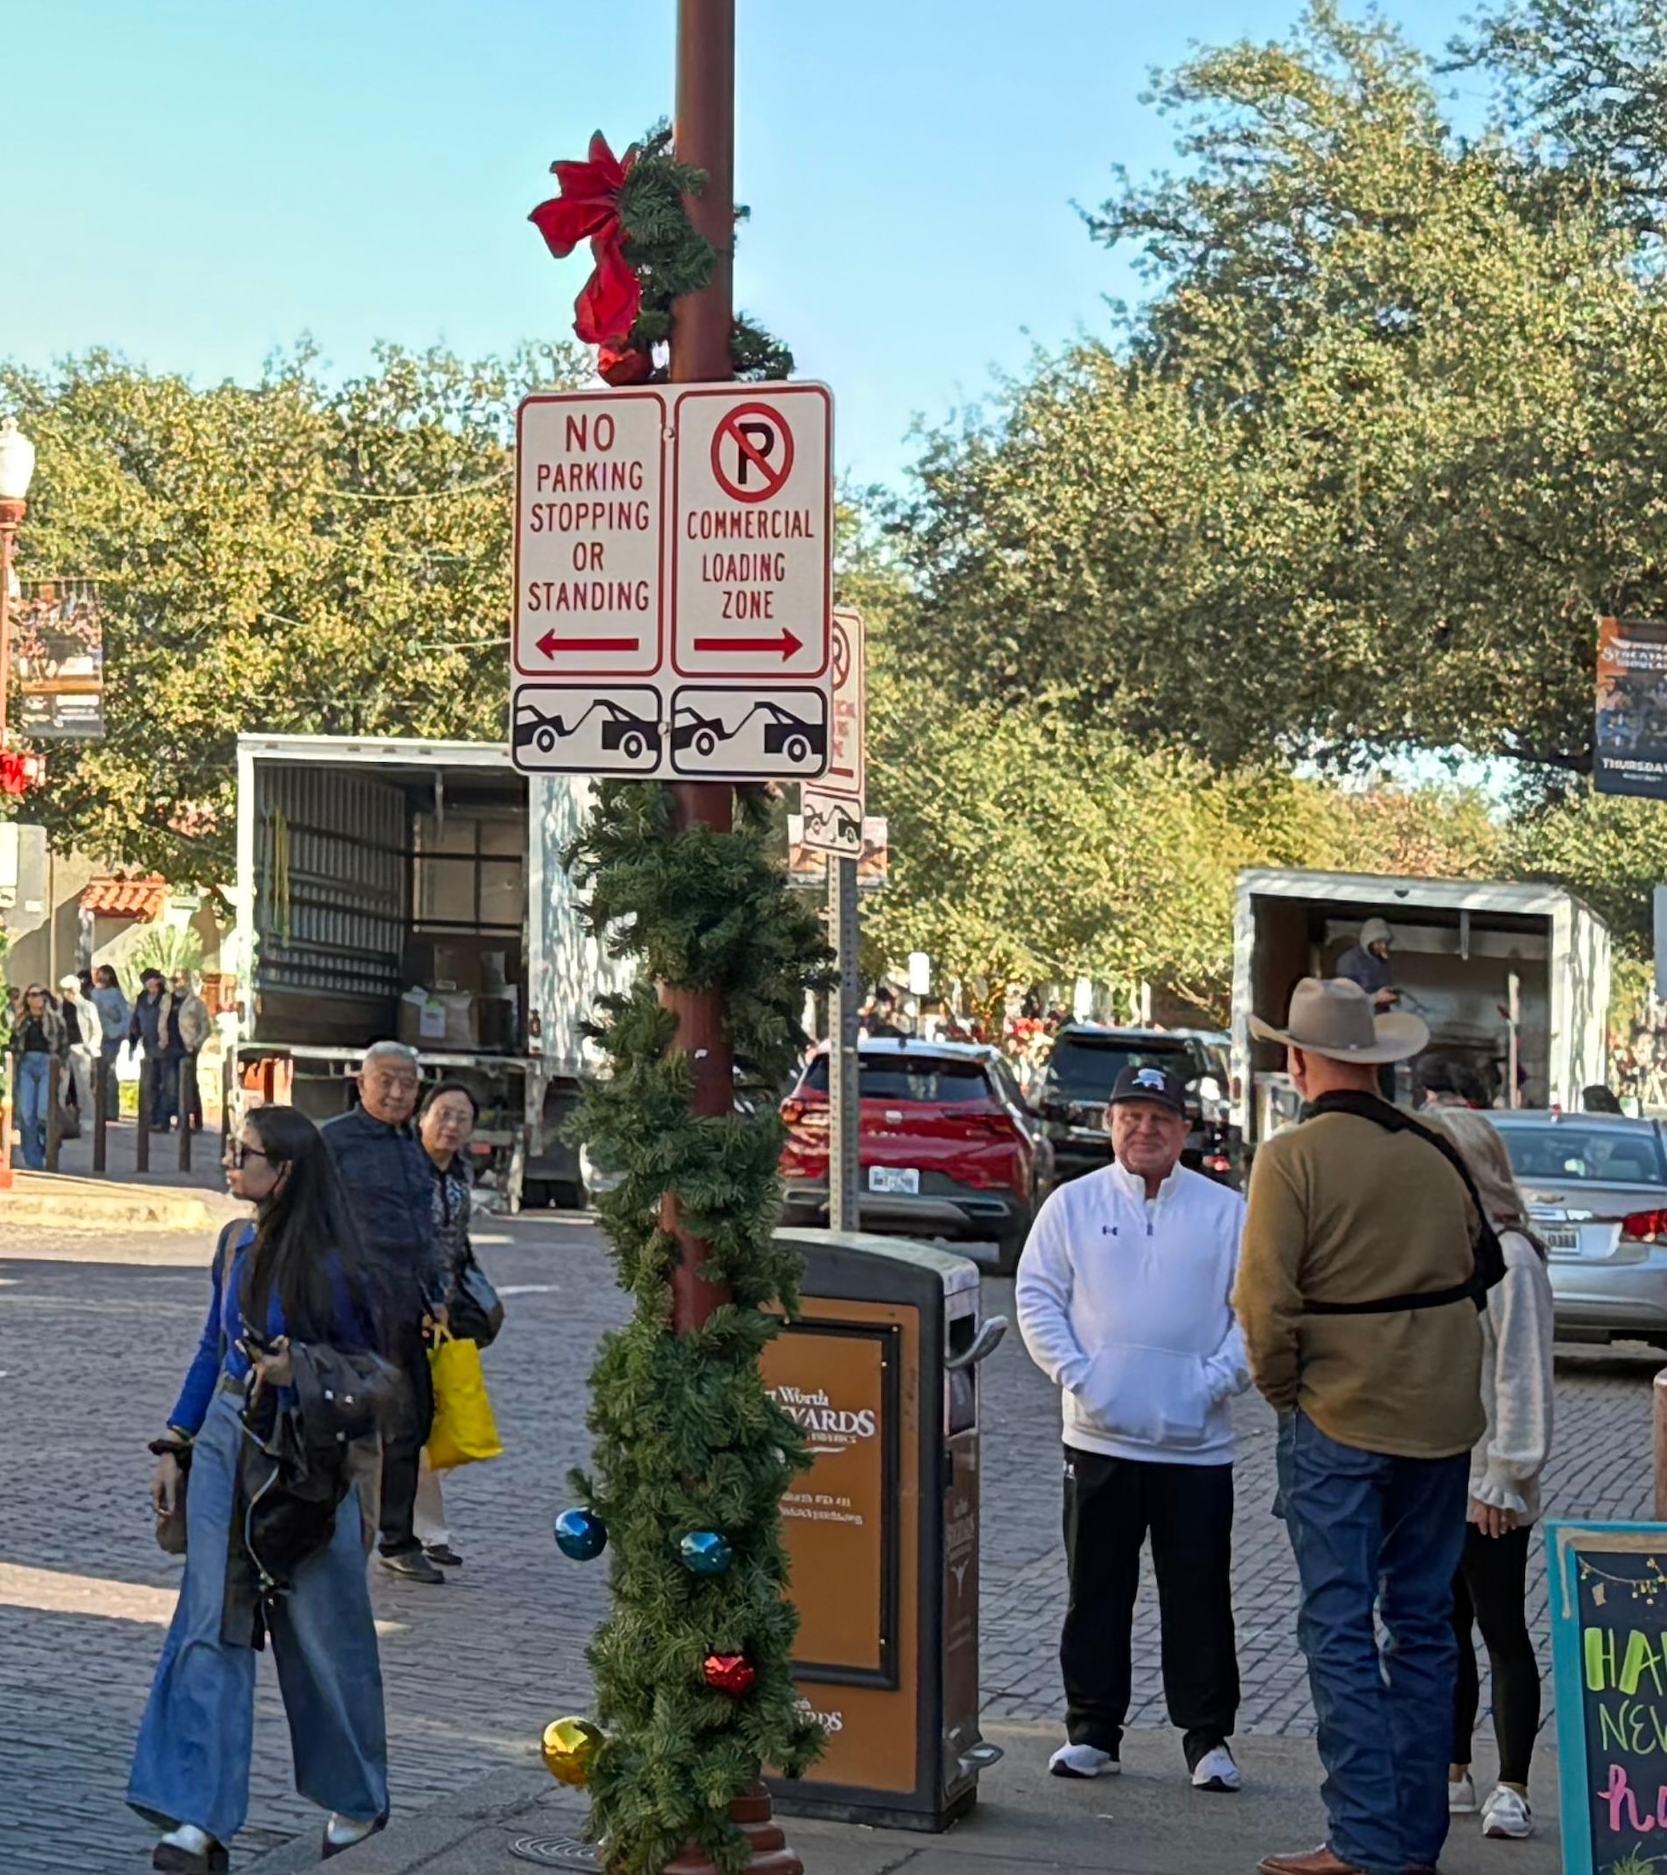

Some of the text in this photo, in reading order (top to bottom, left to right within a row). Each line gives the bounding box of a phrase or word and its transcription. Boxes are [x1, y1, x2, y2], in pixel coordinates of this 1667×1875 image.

[565, 413, 615, 452] NO
[537, 461, 643, 492] PARKING
[530, 501, 649, 532] STOPPING
[687, 509, 814, 539] COMMERCIAL
[572, 542, 604, 571] OR
[702, 553, 785, 583] LOADING
[528, 580, 649, 611] STANDING
[722, 591, 774, 619] ZONE
[1584, 1626, 1667, 1696] HA
